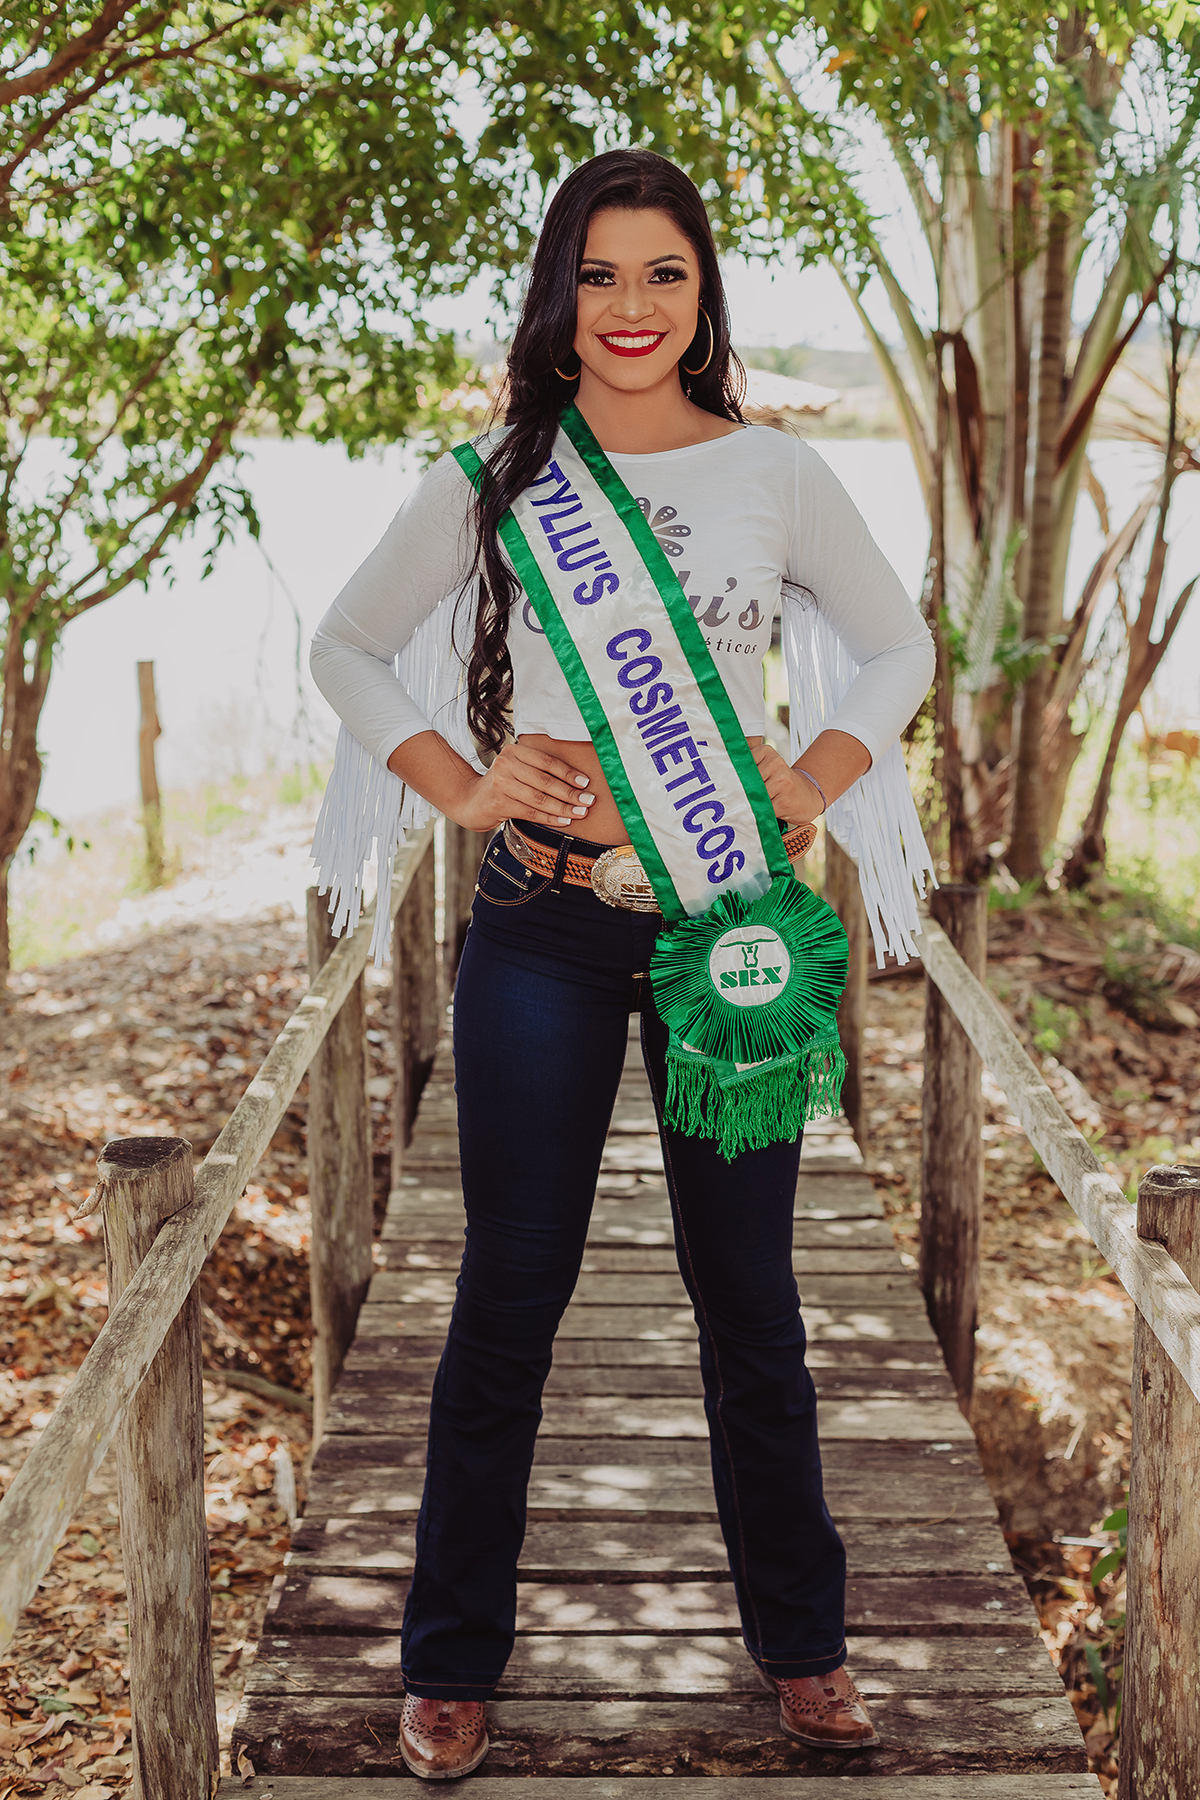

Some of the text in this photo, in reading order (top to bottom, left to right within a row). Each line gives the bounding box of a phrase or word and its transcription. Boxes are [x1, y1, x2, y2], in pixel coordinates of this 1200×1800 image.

[528, 450, 745, 884] TYLLU'S COSMÉTICOS
[719, 966, 782, 989] SRX
